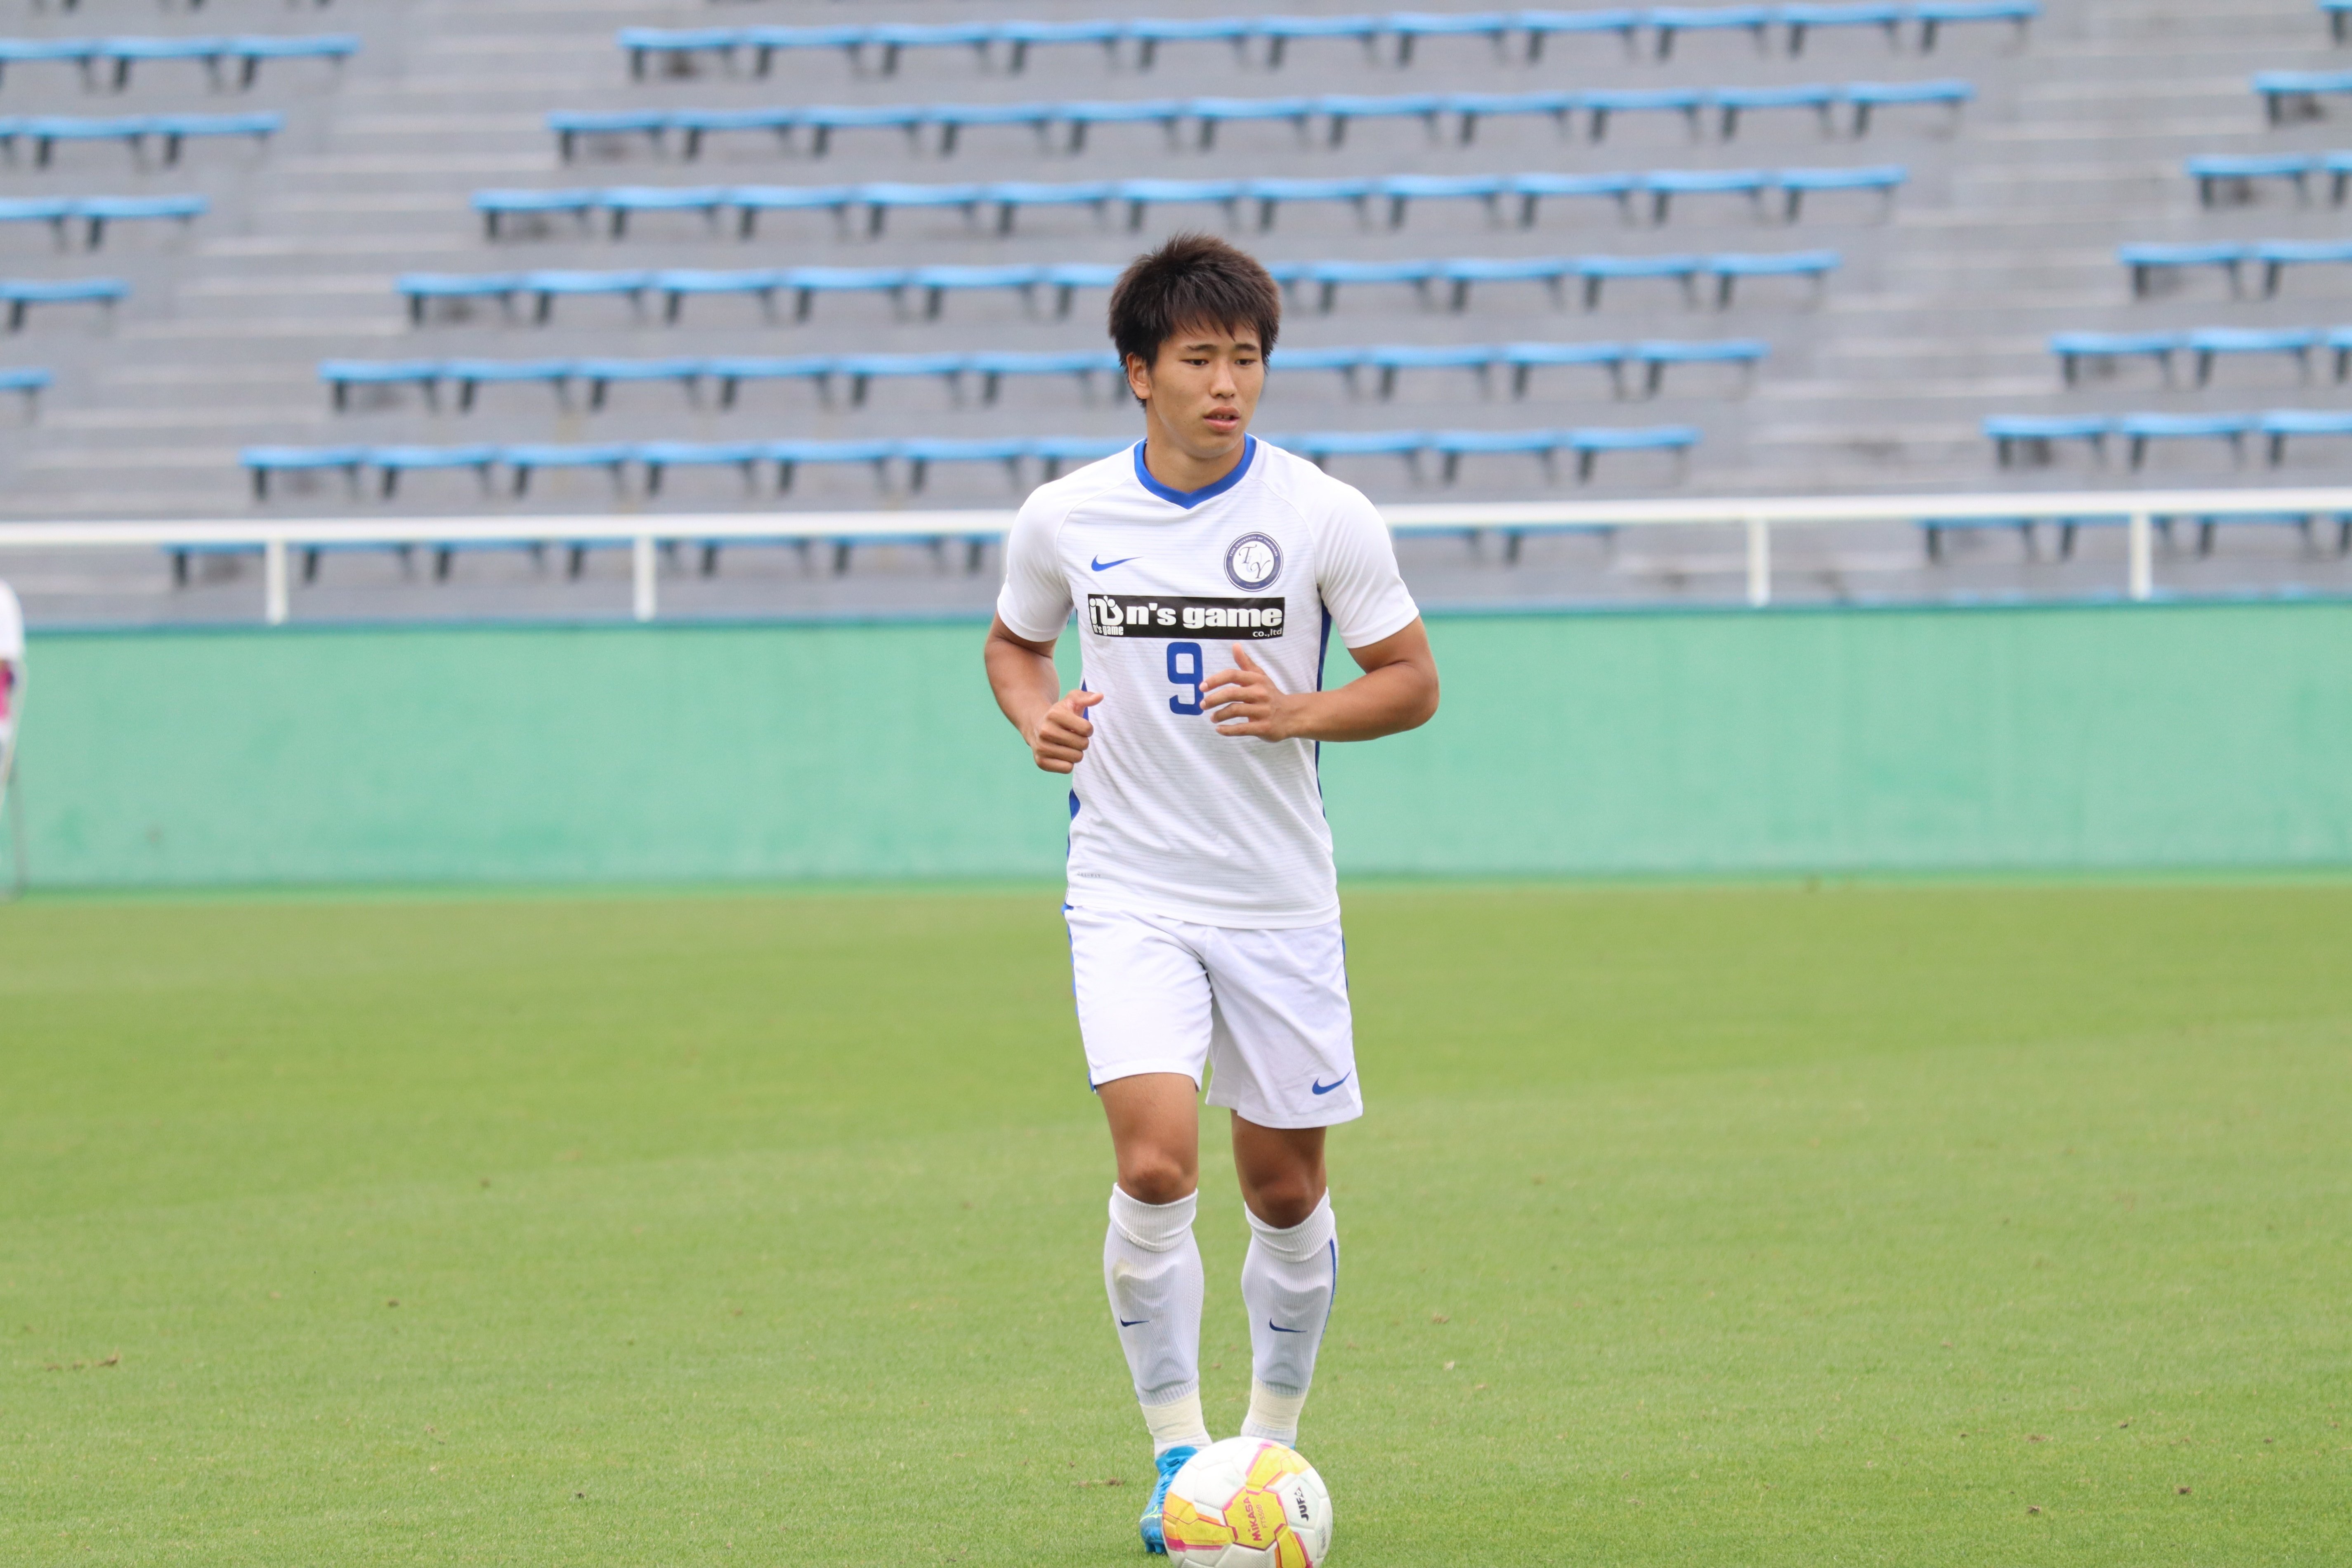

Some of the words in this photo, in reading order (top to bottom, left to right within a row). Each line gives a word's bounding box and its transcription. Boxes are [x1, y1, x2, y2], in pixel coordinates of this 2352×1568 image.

[1235, 536, 1256, 547] UNIVERSITY
[1126, 603, 1176, 626] n's
[1183, 607, 1282, 629] game
[1093, 624, 1103, 634] n's
[1103, 626, 1124, 635] game
[1167, 642, 1204, 716] 9
